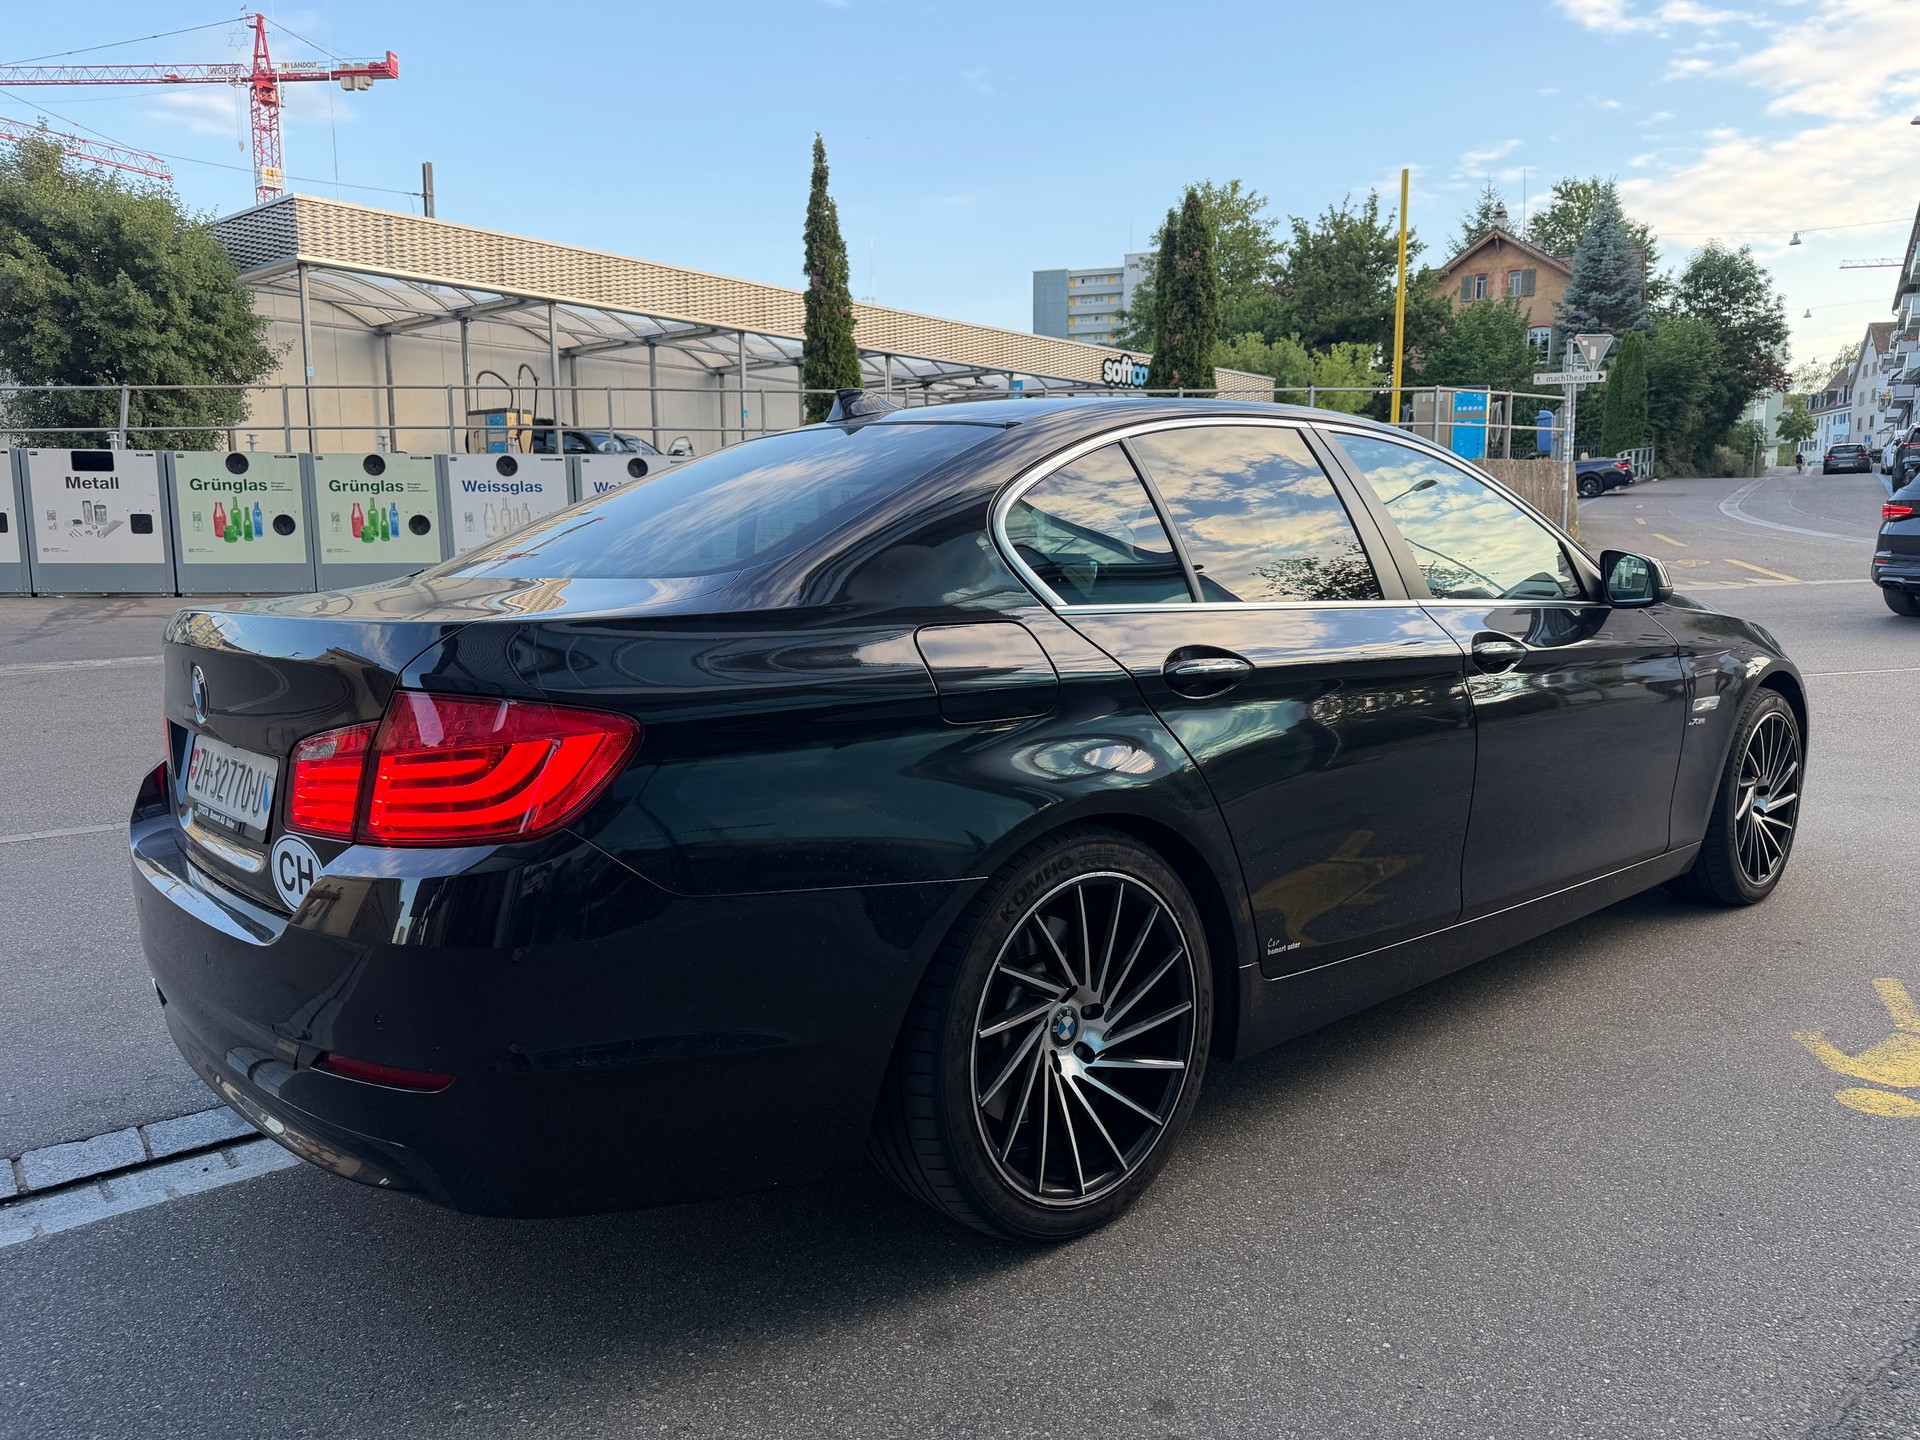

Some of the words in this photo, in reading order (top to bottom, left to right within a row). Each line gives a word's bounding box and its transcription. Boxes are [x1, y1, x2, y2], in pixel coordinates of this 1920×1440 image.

[290, 61, 317, 69] LANDOLT
[1546, 373, 1593, 383] machTheater
[65, 476, 120, 490] Metall
[189, 478, 268, 494] Grünglas
[328, 479, 404, 495] Grünglas
[461, 480, 543, 495] Weissglas
[279, 850, 314, 895] CH
[1000, 856, 1074, 923] KUMHO
